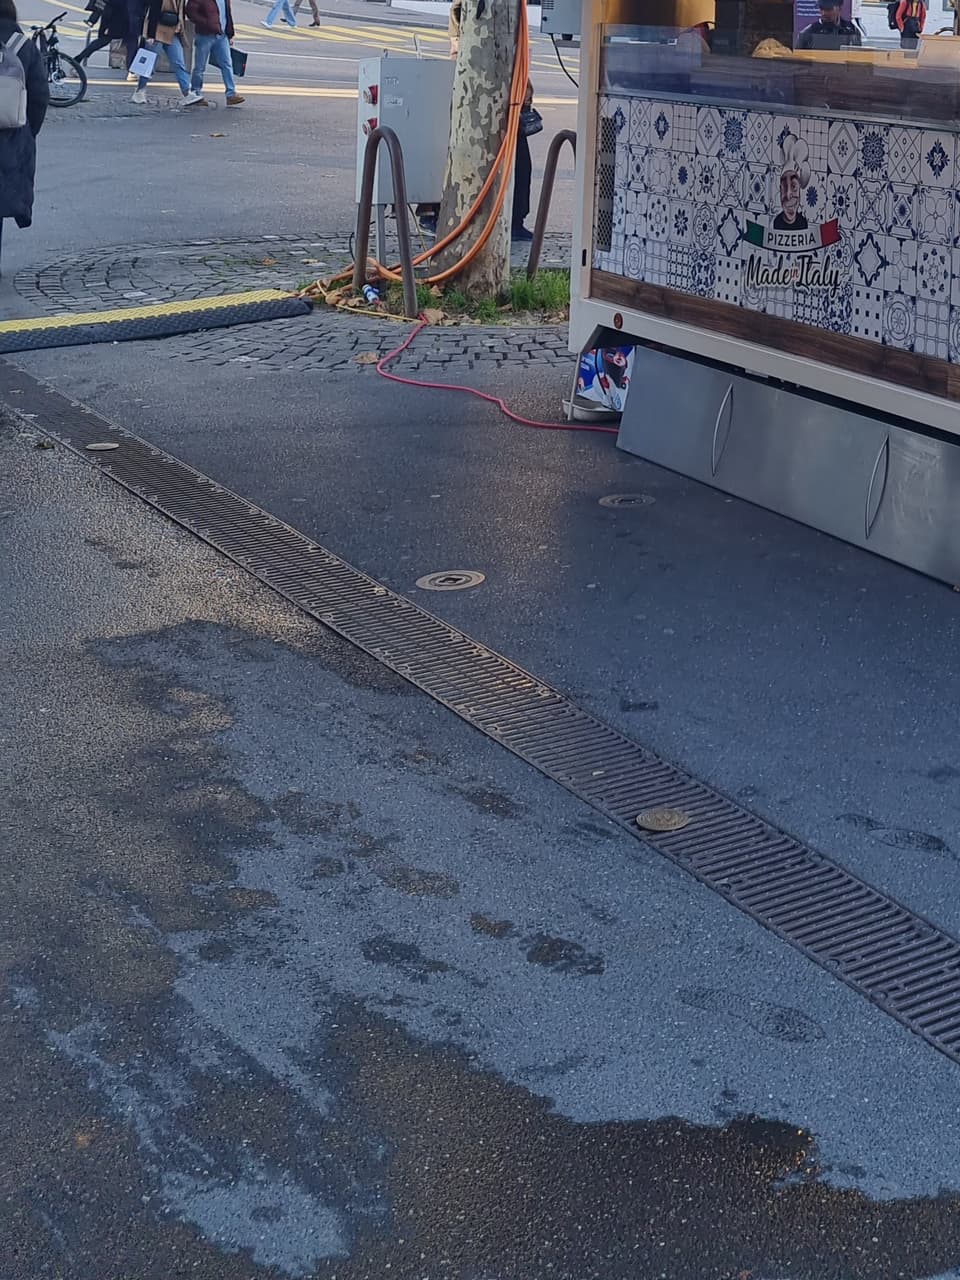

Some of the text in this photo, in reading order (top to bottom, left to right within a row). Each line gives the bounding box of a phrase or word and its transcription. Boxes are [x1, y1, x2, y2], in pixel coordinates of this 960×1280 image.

[767, 232, 817, 247] PIZZERIA
[746, 253, 841, 298] Made in Italy
